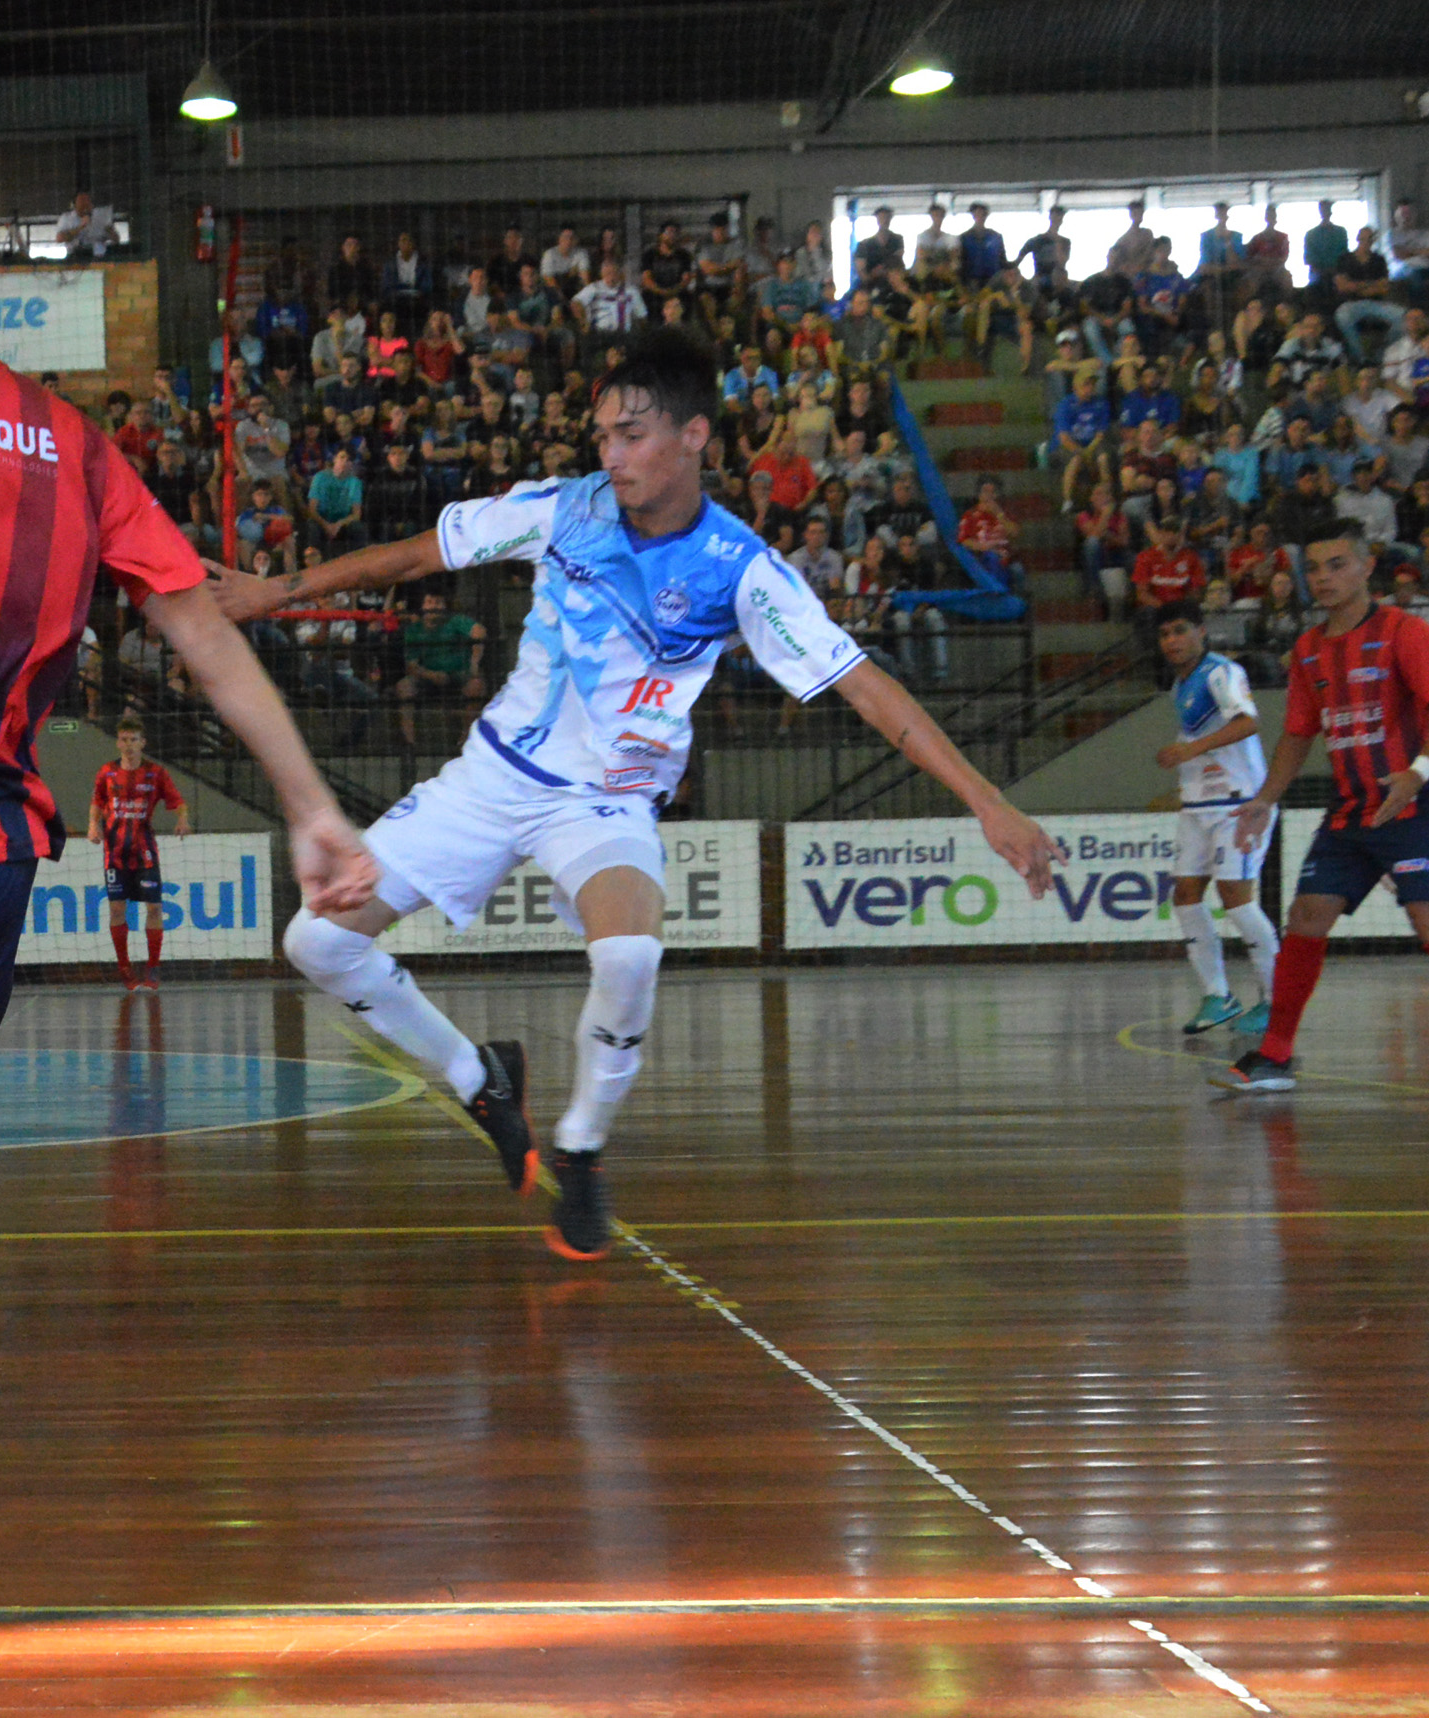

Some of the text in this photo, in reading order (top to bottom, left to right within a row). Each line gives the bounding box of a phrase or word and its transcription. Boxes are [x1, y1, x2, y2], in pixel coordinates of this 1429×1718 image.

[616, 677, 675, 713] JR
[833, 836, 956, 866] Banrisul
[107, 868, 116, 883] 8
[802, 873, 999, 928] vero
[445, 929, 557, 947] CONHECIMENTO
